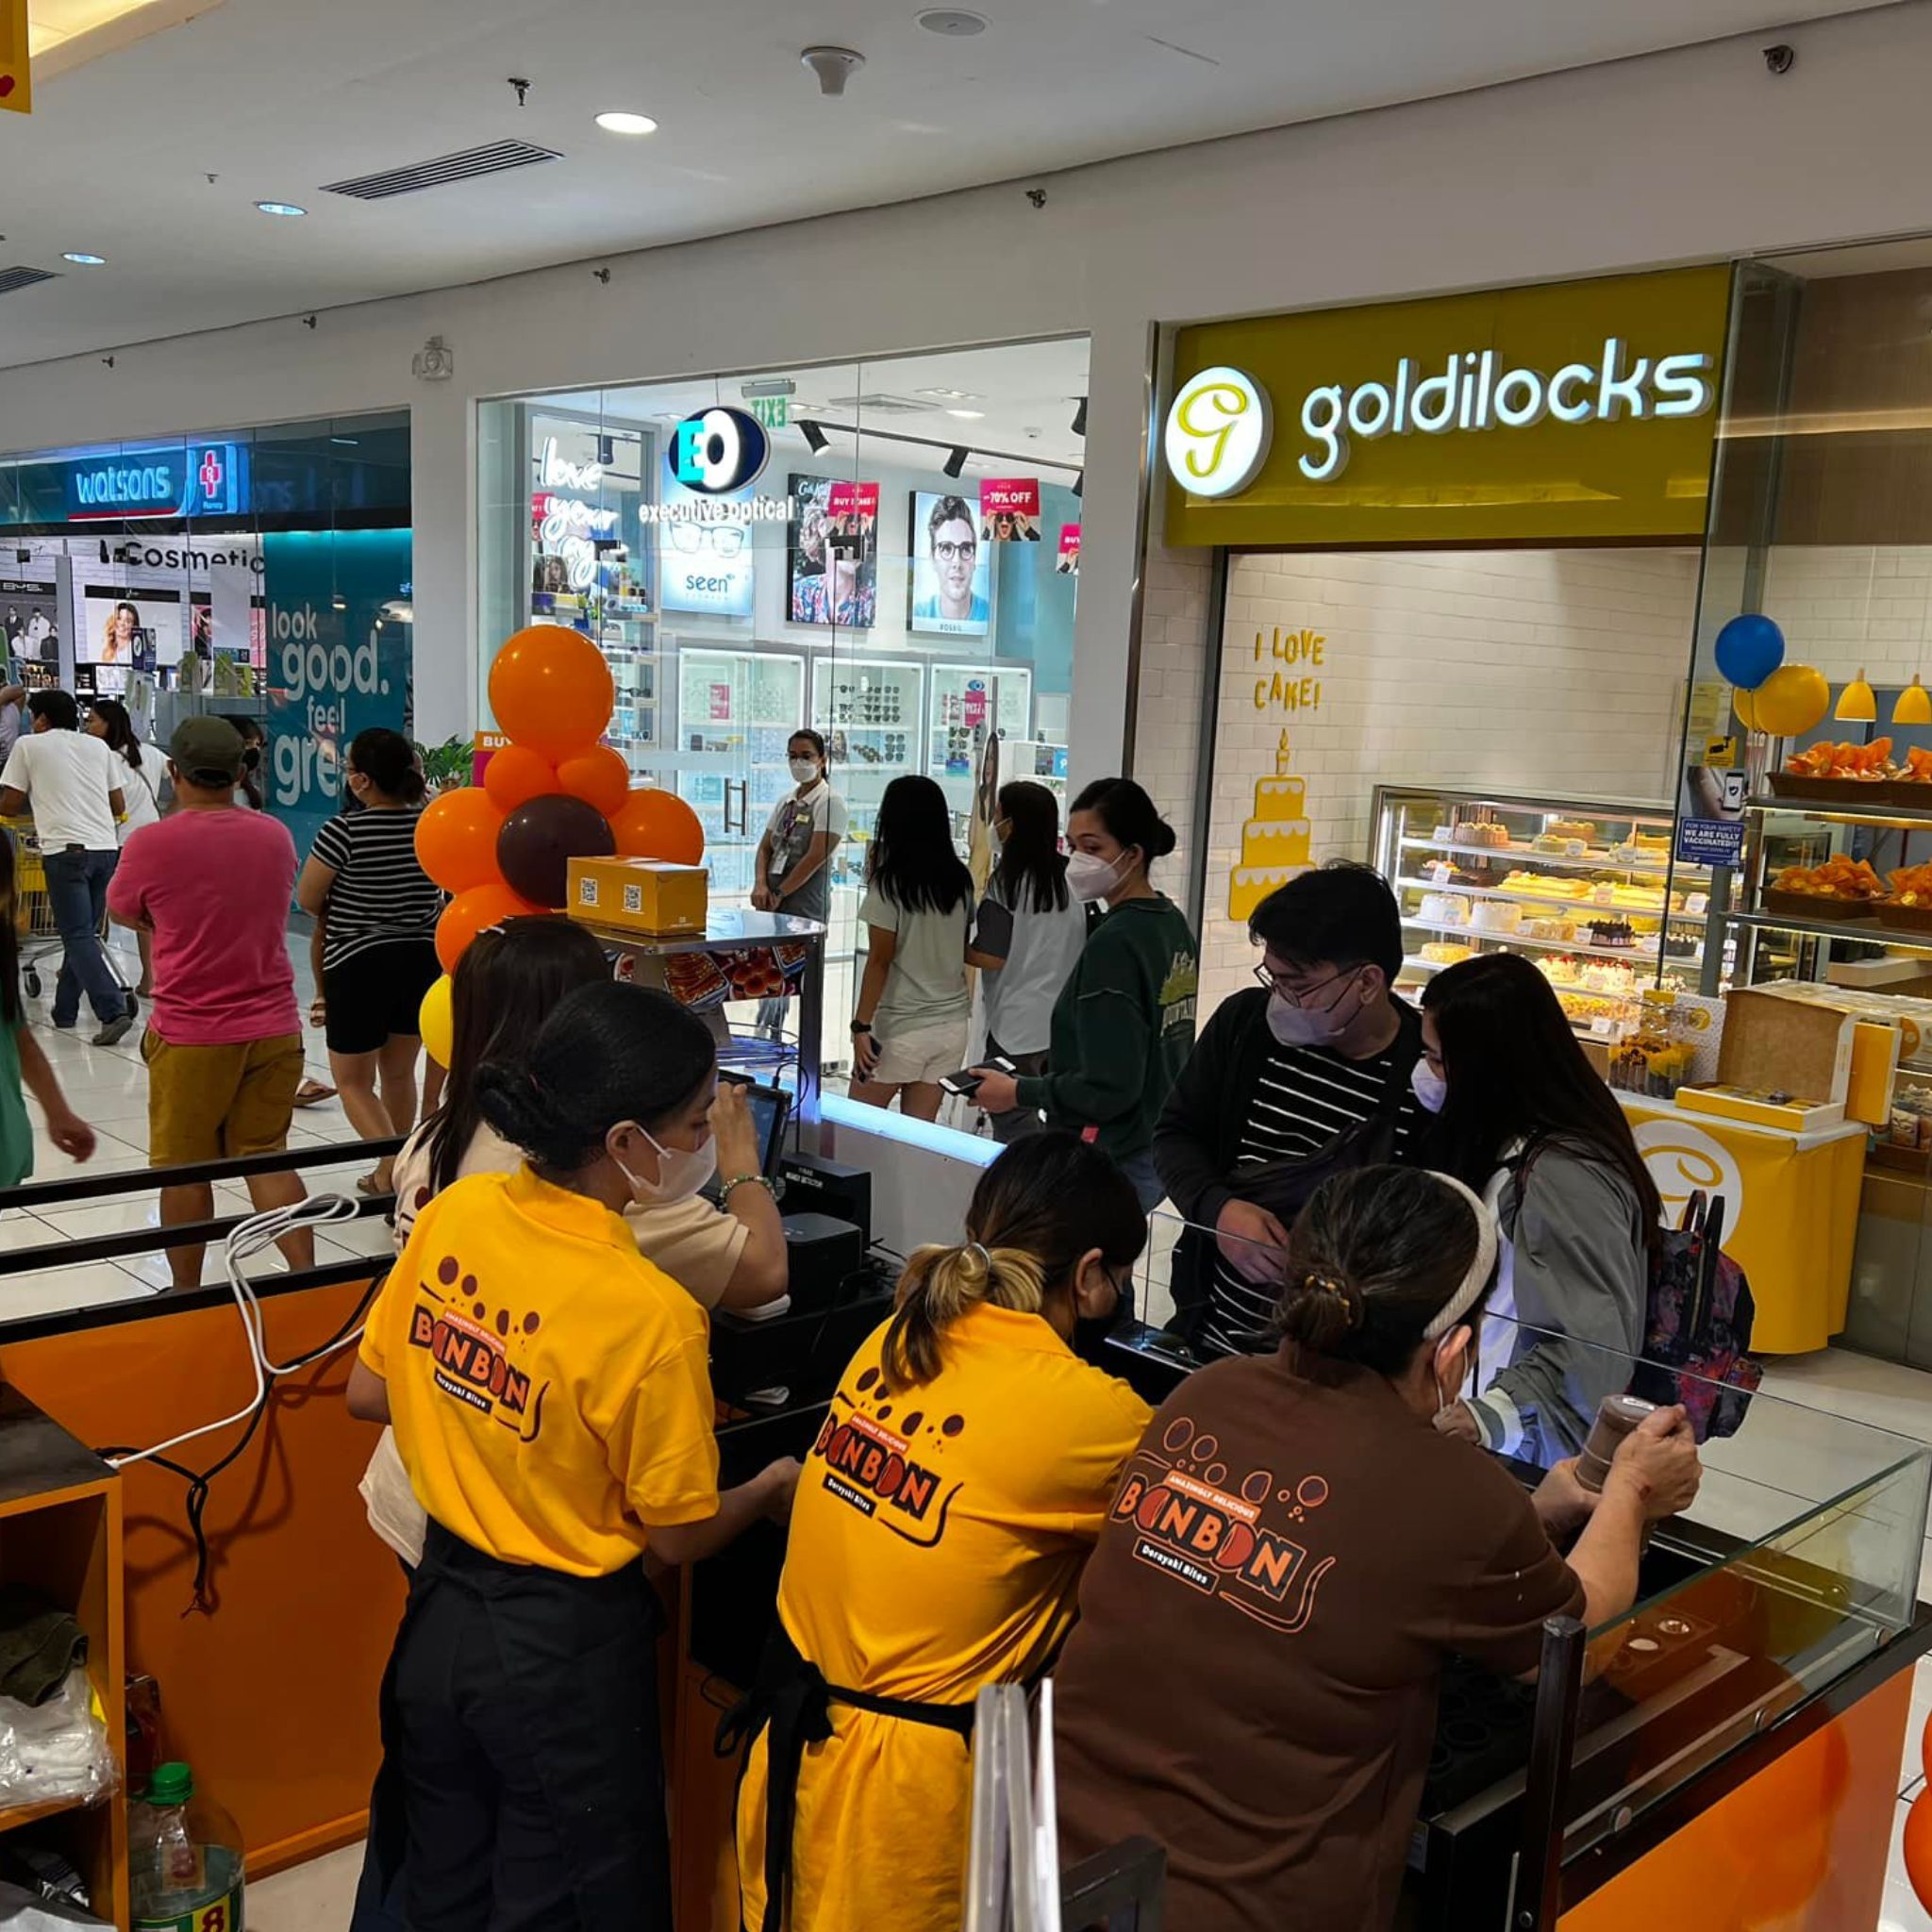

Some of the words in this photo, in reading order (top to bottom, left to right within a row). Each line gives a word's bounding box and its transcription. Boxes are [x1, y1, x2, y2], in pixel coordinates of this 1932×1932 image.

[1298, 339, 1706, 479] goldilocks
[676, 409, 741, 490] EO
[76, 466, 172, 504] watsons
[1010, 491, 1032, 504] OFF
[639, 500, 726, 523] executive
[727, 496, 794, 525] optical
[686, 574, 728, 593] seen
[272, 601, 317, 641] look
[283, 628, 390, 702] good.
[1255, 632, 1262, 662] I
[1273, 626, 1326, 665] LOVE
[1255, 671, 1321, 712] CAKE!
[307, 694, 346, 735] feel
[1699, 830, 1715, 839] ARE
[1717, 831, 1740, 840] FULLY
[1170, 1474, 1212, 1500] AMAZINGLY
[1213, 1492, 1255, 1519] DELICIOUS
[1182, 1564, 1208, 1585] Bites
